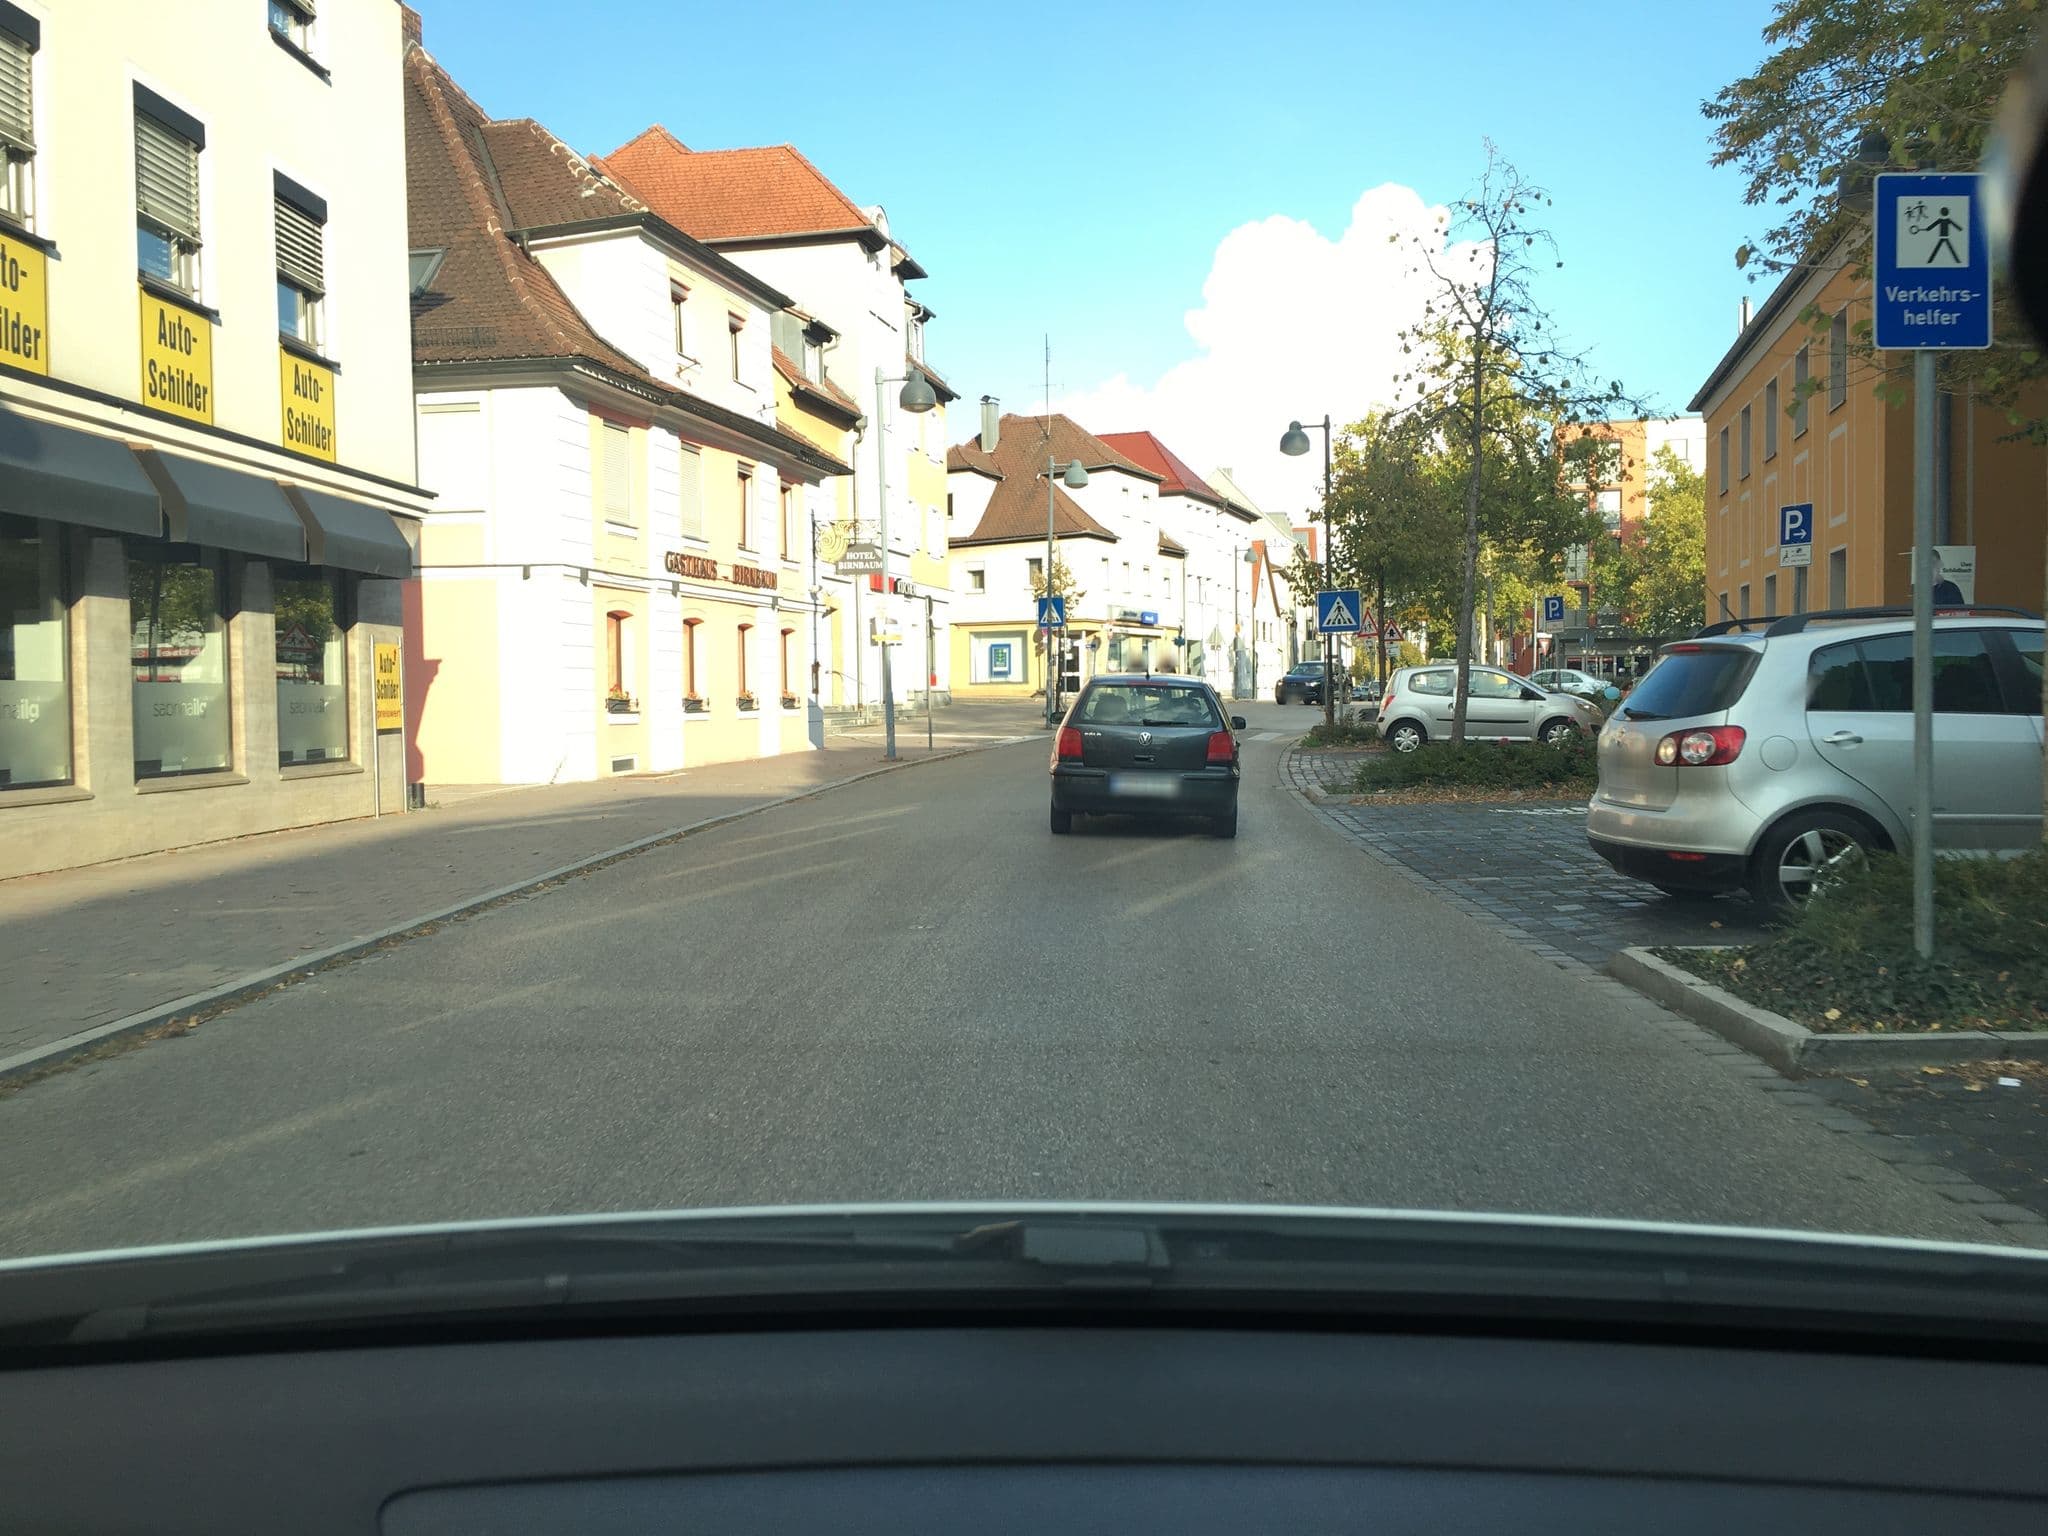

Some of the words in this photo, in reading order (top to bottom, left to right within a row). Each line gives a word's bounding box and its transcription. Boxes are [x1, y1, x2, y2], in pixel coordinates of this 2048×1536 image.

[1884, 286, 1981, 302] Verkehrs-
[1903, 308, 1962, 325] helfer
[158, 307, 198, 356] Auto-
[148, 358, 208, 413] Schilder
[294, 363, 324, 403] Auto-
[287, 406, 332, 452] Schilder
[1785, 510, 1803, 541] P
[838, 561, 883, 570] BIRNBAUM
[846, 551, 877, 561] HOTEL
[665, 551, 718, 581] GASTHAUS
[732, 564, 778, 591] BIRNBAUM
[1549, 600, 1560, 618] P
[379, 652, 396, 674] Auto-
[376, 679, 399, 700] Schilder
